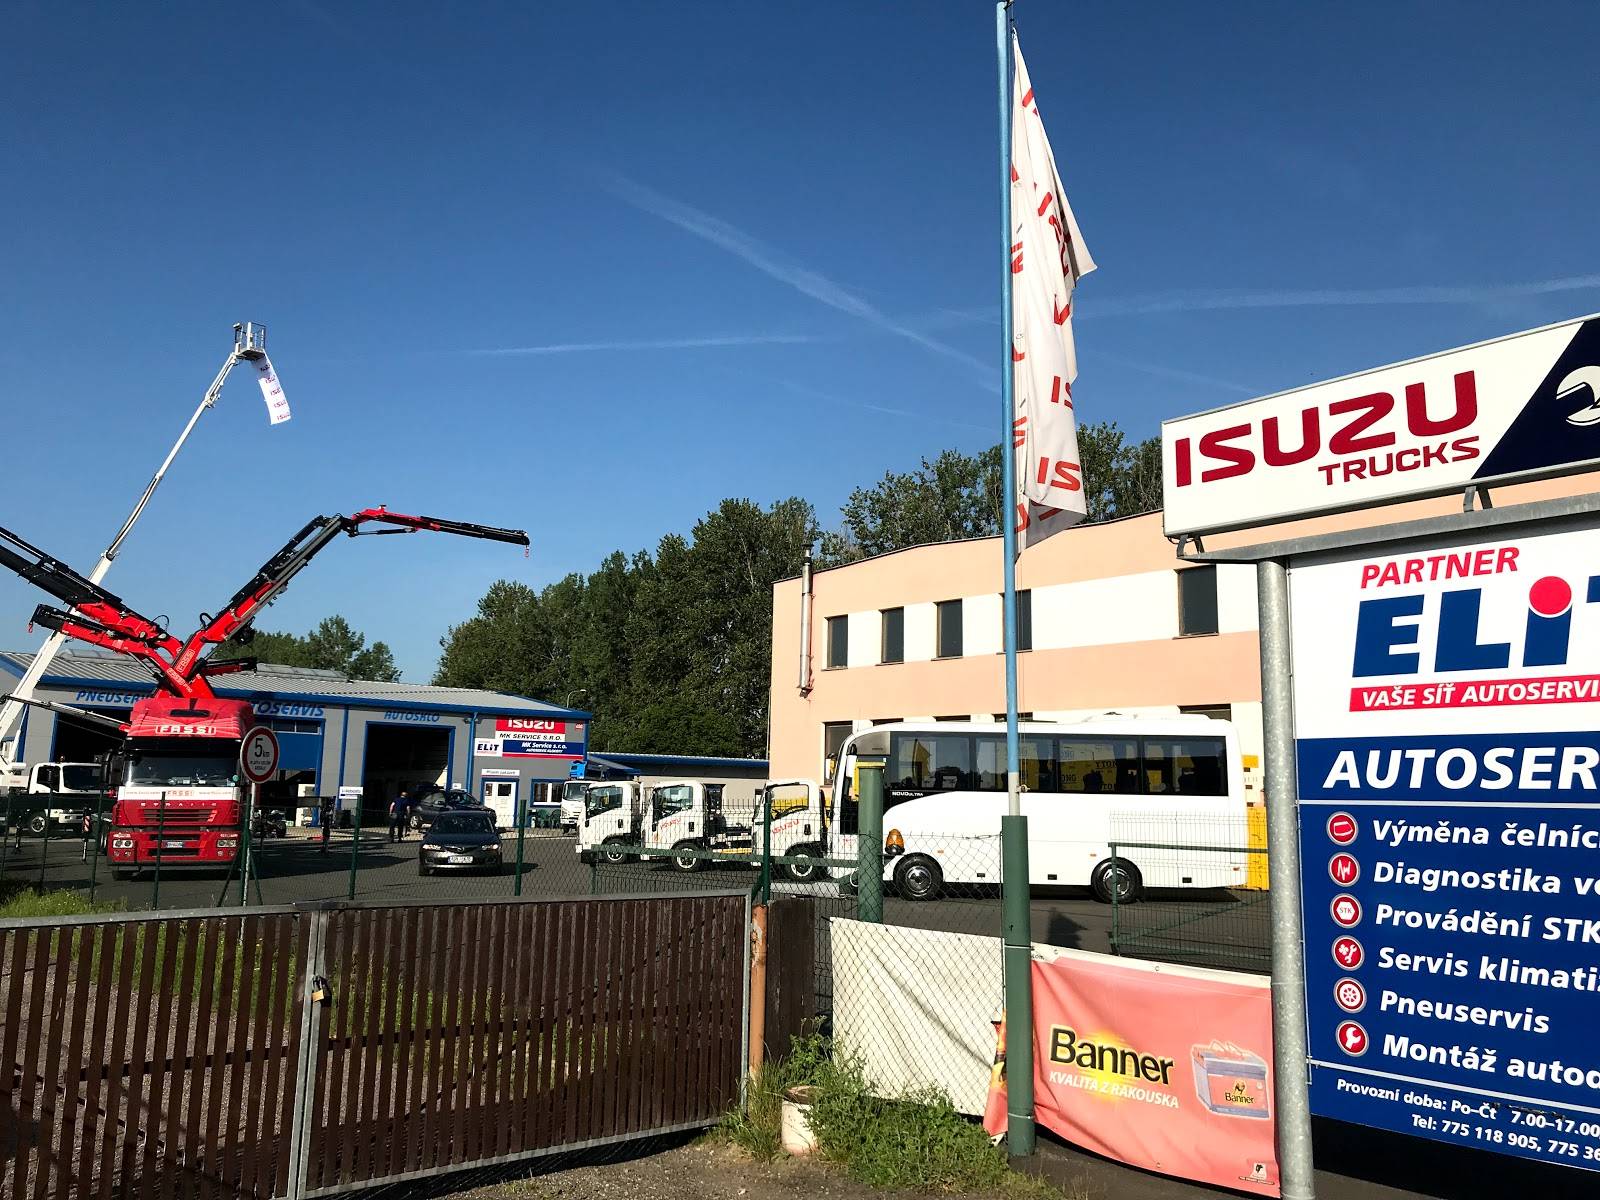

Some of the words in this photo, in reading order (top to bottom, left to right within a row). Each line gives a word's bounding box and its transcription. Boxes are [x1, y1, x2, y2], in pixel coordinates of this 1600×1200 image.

[1175, 370, 1478, 488] ISUZU
[1318, 436, 1480, 485] TRUCKS
[1360, 547, 1520, 589] PARTNER
[1352, 576, 1600, 677] ELi
[76, 690, 140, 704] PNEUSER
[1362, 685, 1416, 707] VAŠE
[1422, 683, 1456, 705] SÍŤ
[1461, 679, 1600, 703] AUTOSERVI
[158, 725, 214, 735] FASSI
[384, 711, 440, 723] AUTOSKLO
[507, 718, 555, 730] ISUZU
[254, 737, 263, 757] 5
[1322, 746, 1600, 790] AUTOSER
[1373, 819, 1489, 847] Výměna
[1500, 822, 1600, 849] čelníc
[1373, 862, 1561, 894] Diagnostika
[1375, 903, 1533, 938] Provádění
[1542, 917, 1600, 943] STK
[1378, 947, 1469, 977] Servis
[1479, 956, 1600, 992] klimati
[1380, 990, 1550, 1034] Pneuservis
[1051, 1027, 1174, 1085] Banner
[1383, 1034, 1497, 1073] Montáž
[1050, 1070, 1098, 1092] KVALITA
[1100, 1081, 1109, 1093] Z
[1112, 1085, 1179, 1109] RAKOUSKA
[1225, 1092, 1254, 1104] Banner
[1337, 1078, 1400, 1102] Provozní
[1403, 1091, 1447, 1110] doba:
[1412, 1114, 1437, 1131] Tel:
[1441, 1119, 1470, 1137] 775
[1474, 1127, 1503, 1144] 118
[1508, 1133, 1542, 1152] 905,
[1548, 1139, 1579, 1157] 775
